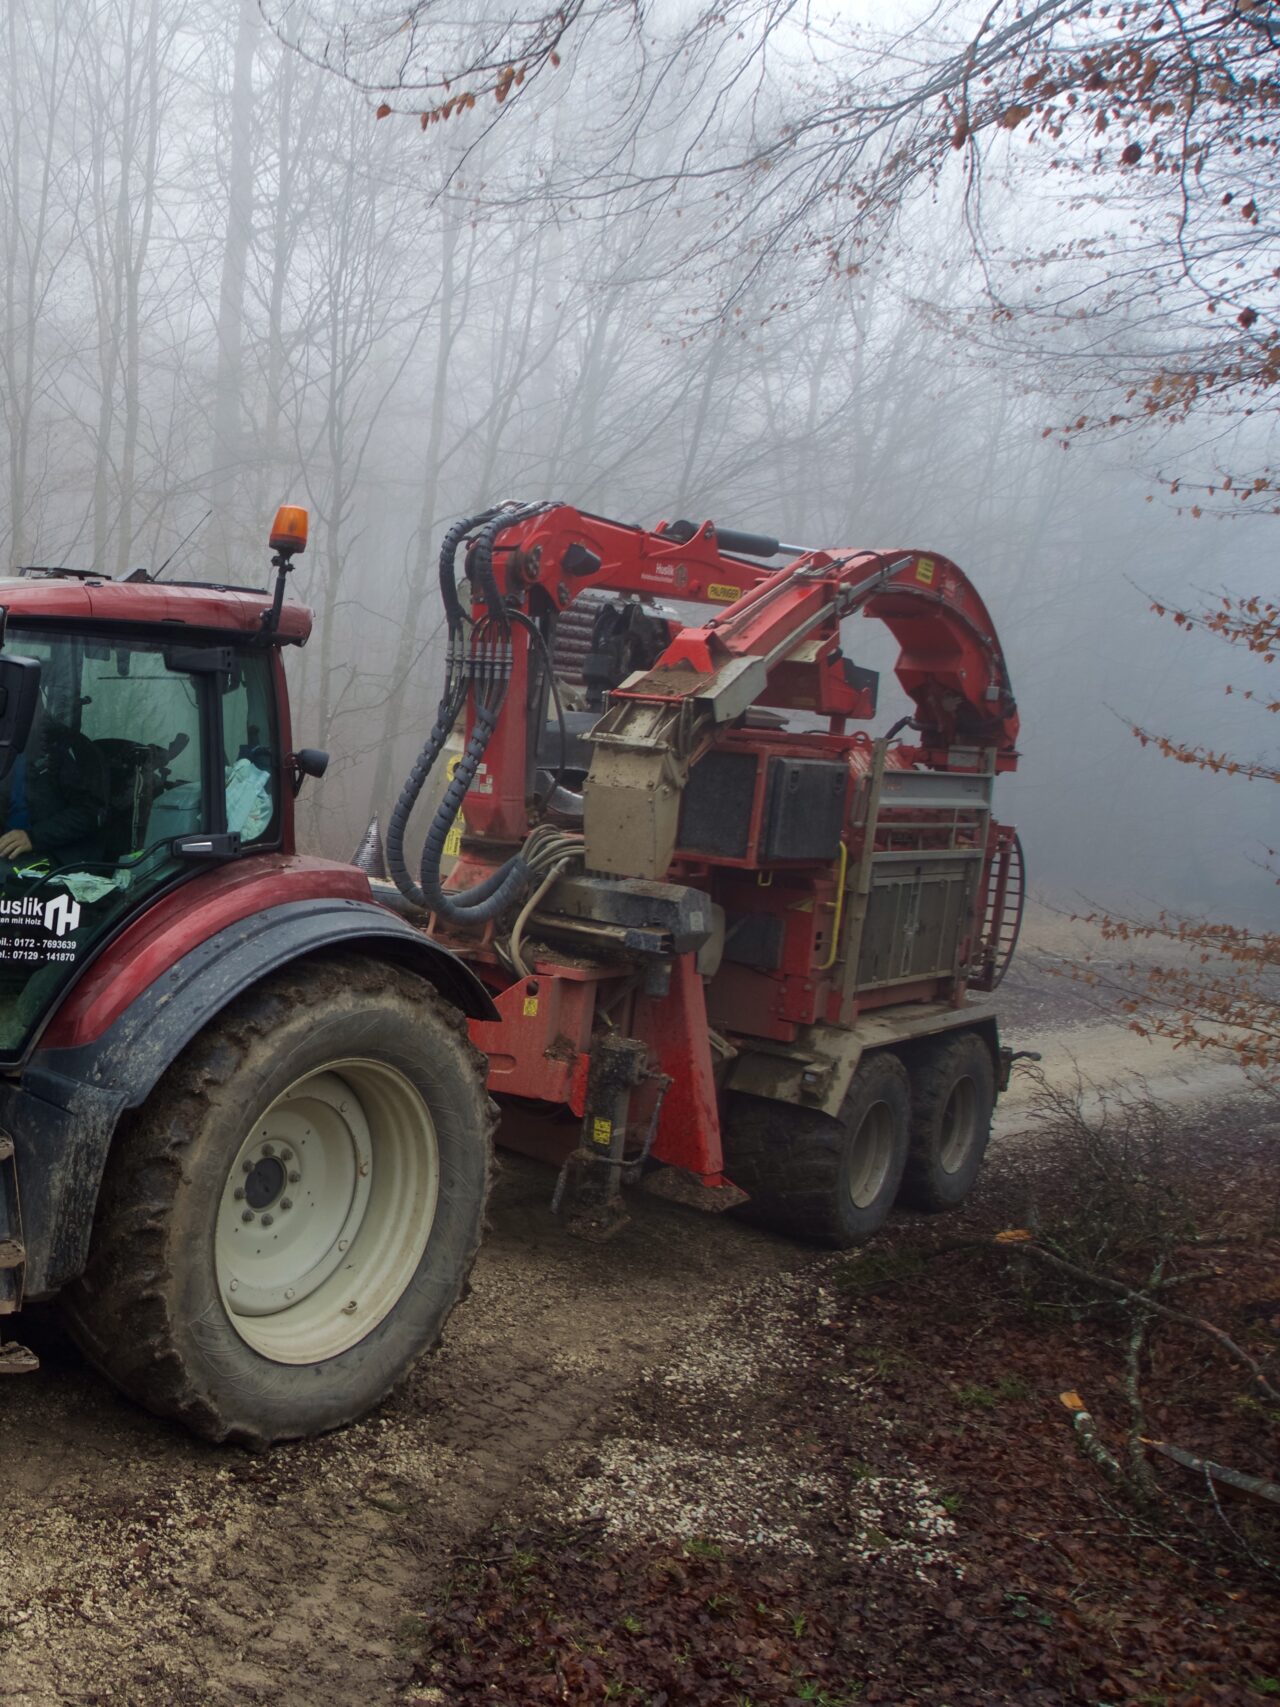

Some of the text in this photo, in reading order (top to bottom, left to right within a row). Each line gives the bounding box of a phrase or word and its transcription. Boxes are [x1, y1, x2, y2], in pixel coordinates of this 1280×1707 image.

[11, 916, 24, 925] mit
[25, 917, 42, 926] Holz
[14, 938, 35, 948] 0172
[42, 939, 77, 950] 7693639
[12, 951, 38, 960] 07129
[46, 952, 76, 962] 141870
